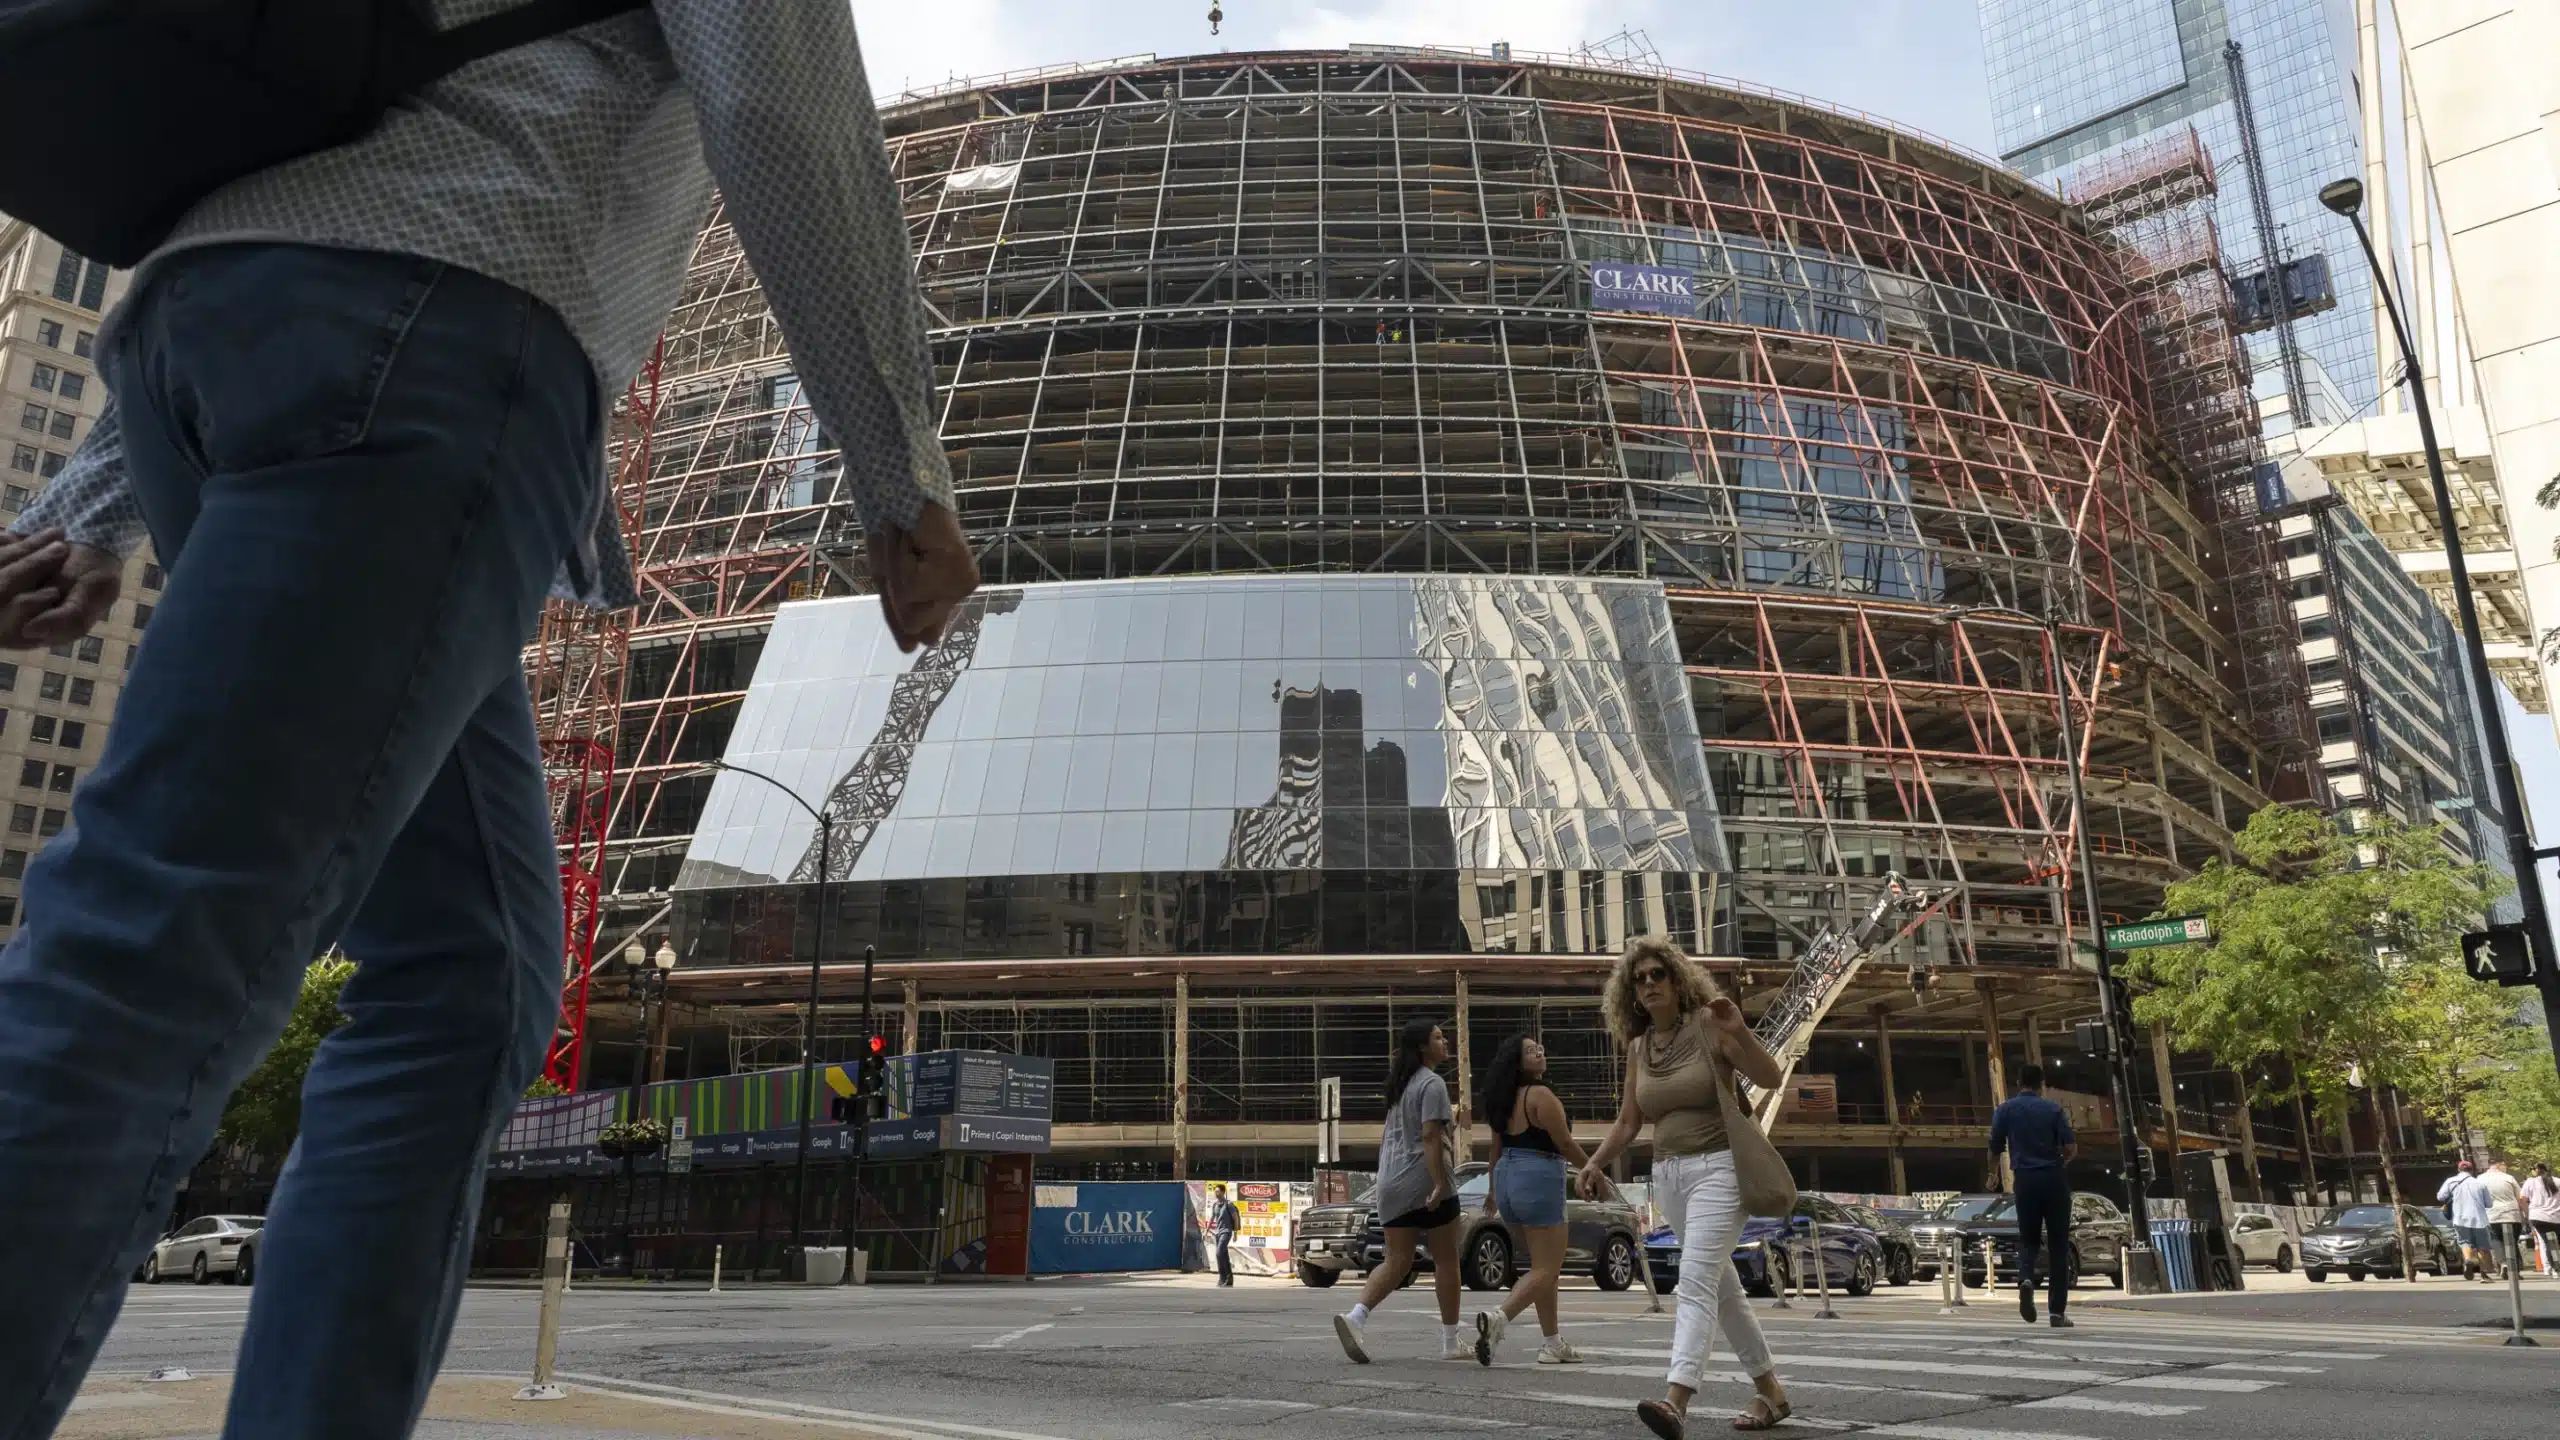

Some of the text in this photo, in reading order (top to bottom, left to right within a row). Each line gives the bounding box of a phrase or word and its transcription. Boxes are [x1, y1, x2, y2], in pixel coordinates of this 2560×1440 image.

[1593, 268, 1692, 296] CLARK
[1594, 290, 1691, 305] CONSTRUCTION
[2117, 925, 2173, 943] Randolph
[812, 1136, 833, 1149] Google
[912, 1128, 936, 1143] Google
[970, 1129, 991, 1140] Prime
[995, 1131, 1015, 1142] Capri
[1015, 1132, 1045, 1142] Interests
[1244, 1185, 1273, 1197] DANGER
[1064, 1209, 1154, 1234] CLARK
[1063, 1235, 1154, 1245] CONSTRUCTION
